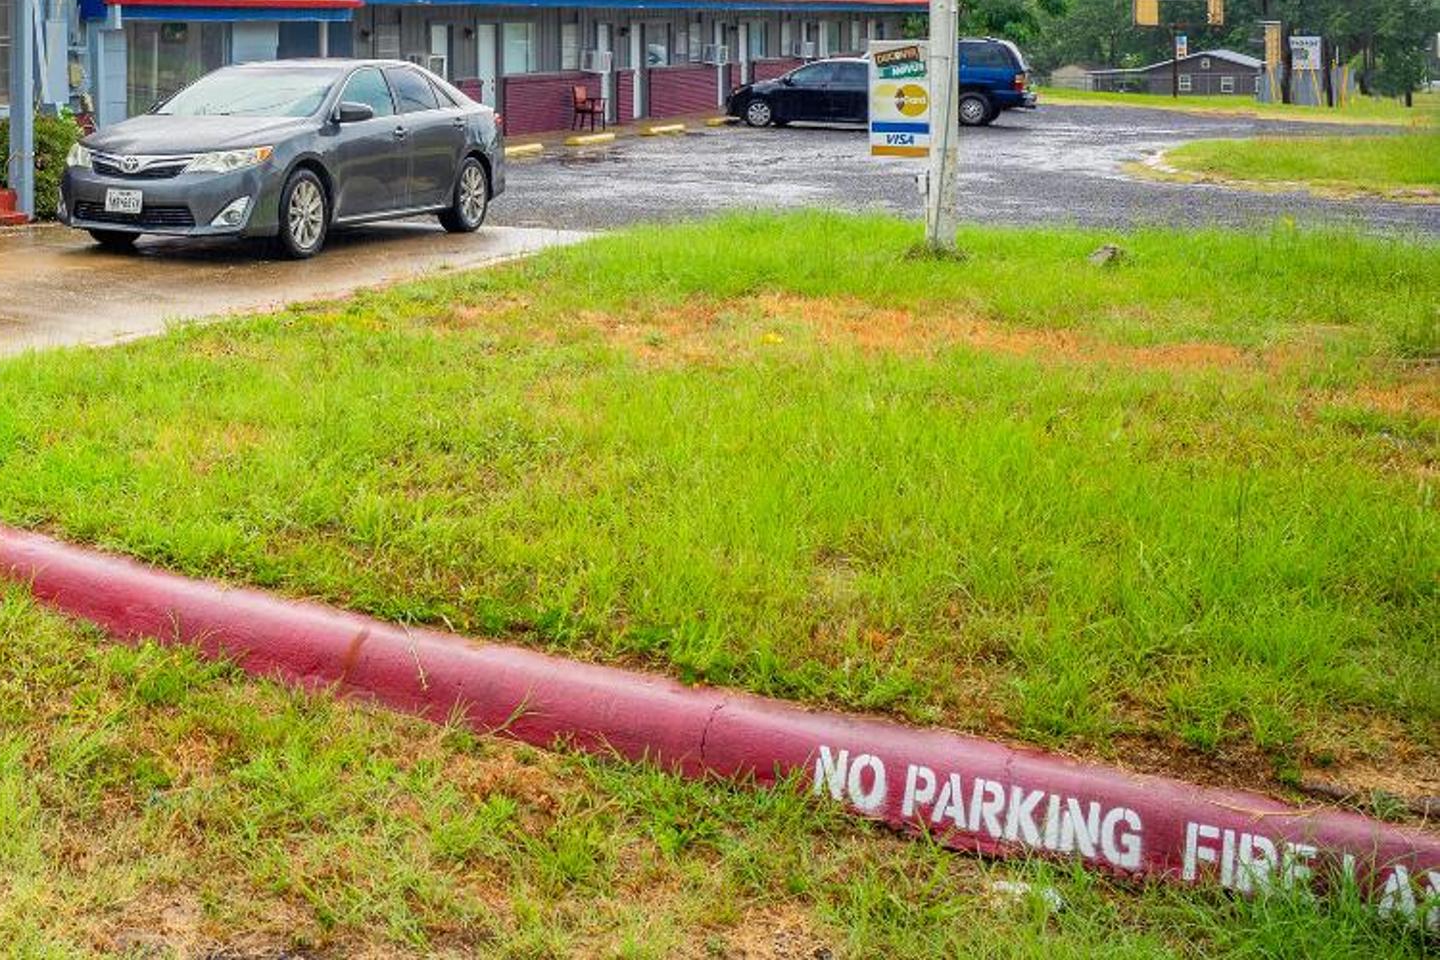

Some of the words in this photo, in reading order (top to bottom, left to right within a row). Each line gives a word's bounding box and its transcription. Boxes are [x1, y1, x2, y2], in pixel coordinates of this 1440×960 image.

[886, 134, 914, 144] VISA
[814, 745, 887, 810] NO
[903, 764, 1142, 871] PARKING
